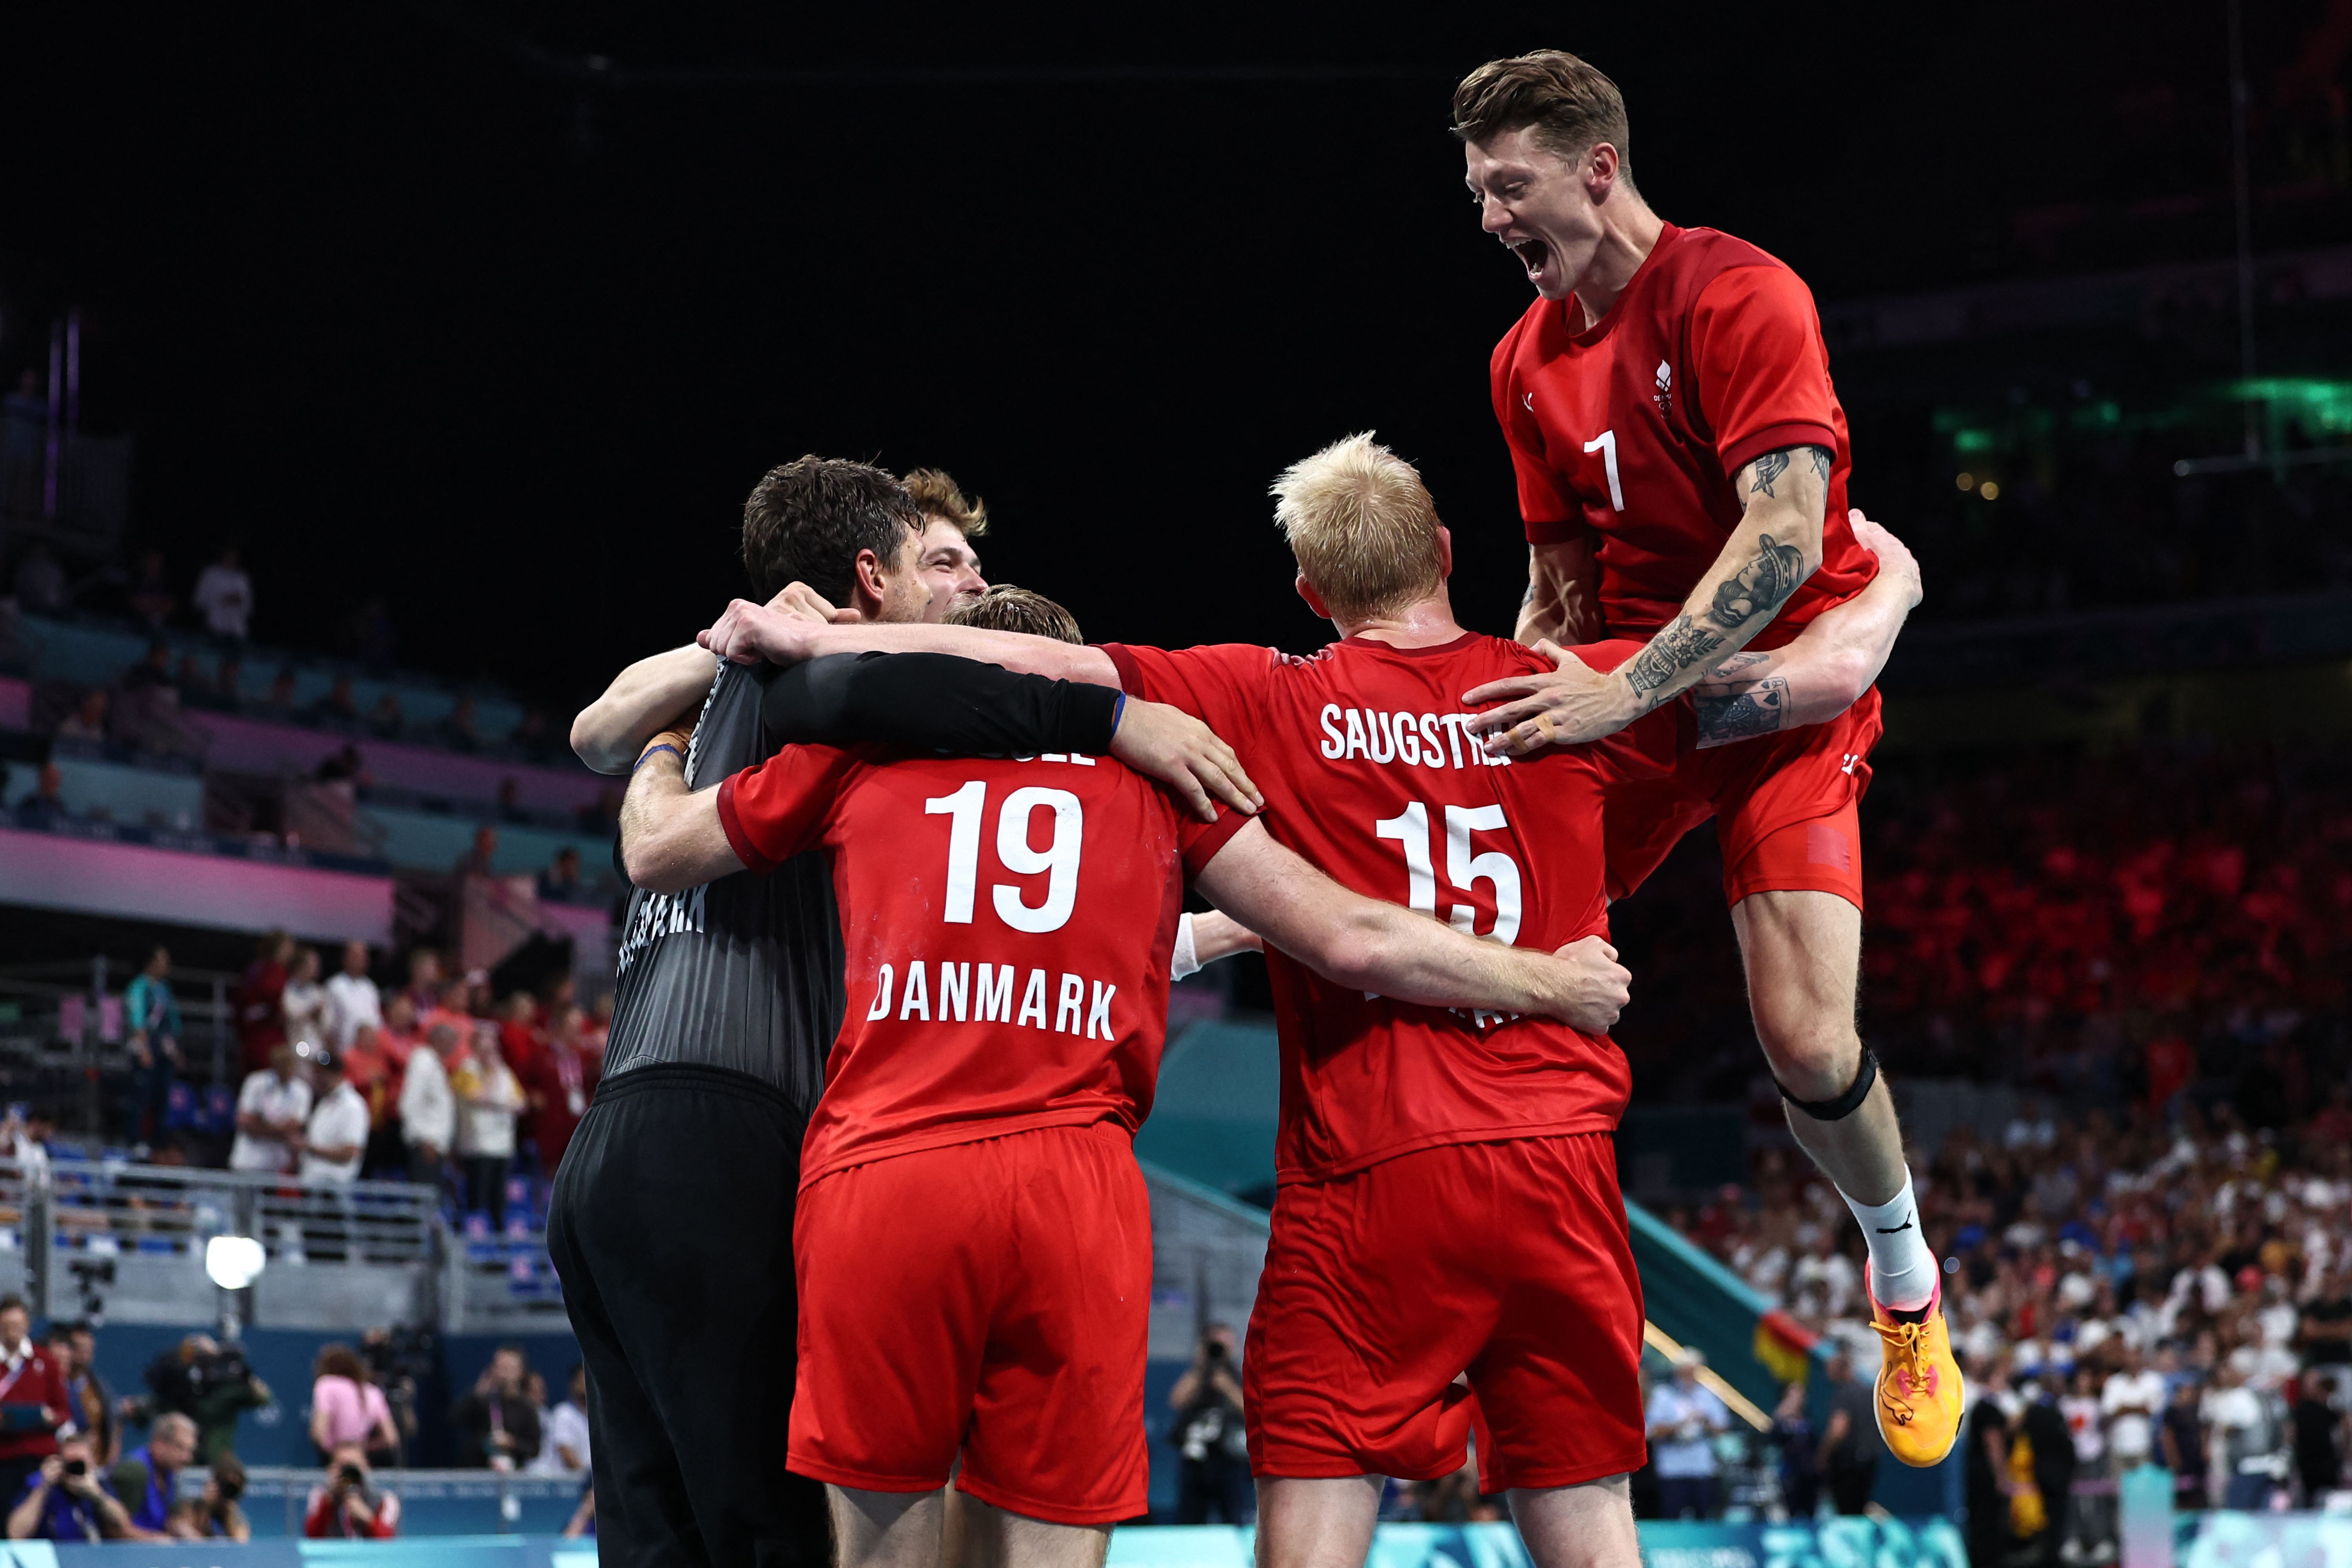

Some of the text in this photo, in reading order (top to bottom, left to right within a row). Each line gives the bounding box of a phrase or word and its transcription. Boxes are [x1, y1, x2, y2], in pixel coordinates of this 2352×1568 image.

[1584, 430, 1624, 511] 7
[925, 780, 1083, 933] 19
[1376, 800, 1522, 948] 15
[866, 960, 1117, 1042] DANMARK
